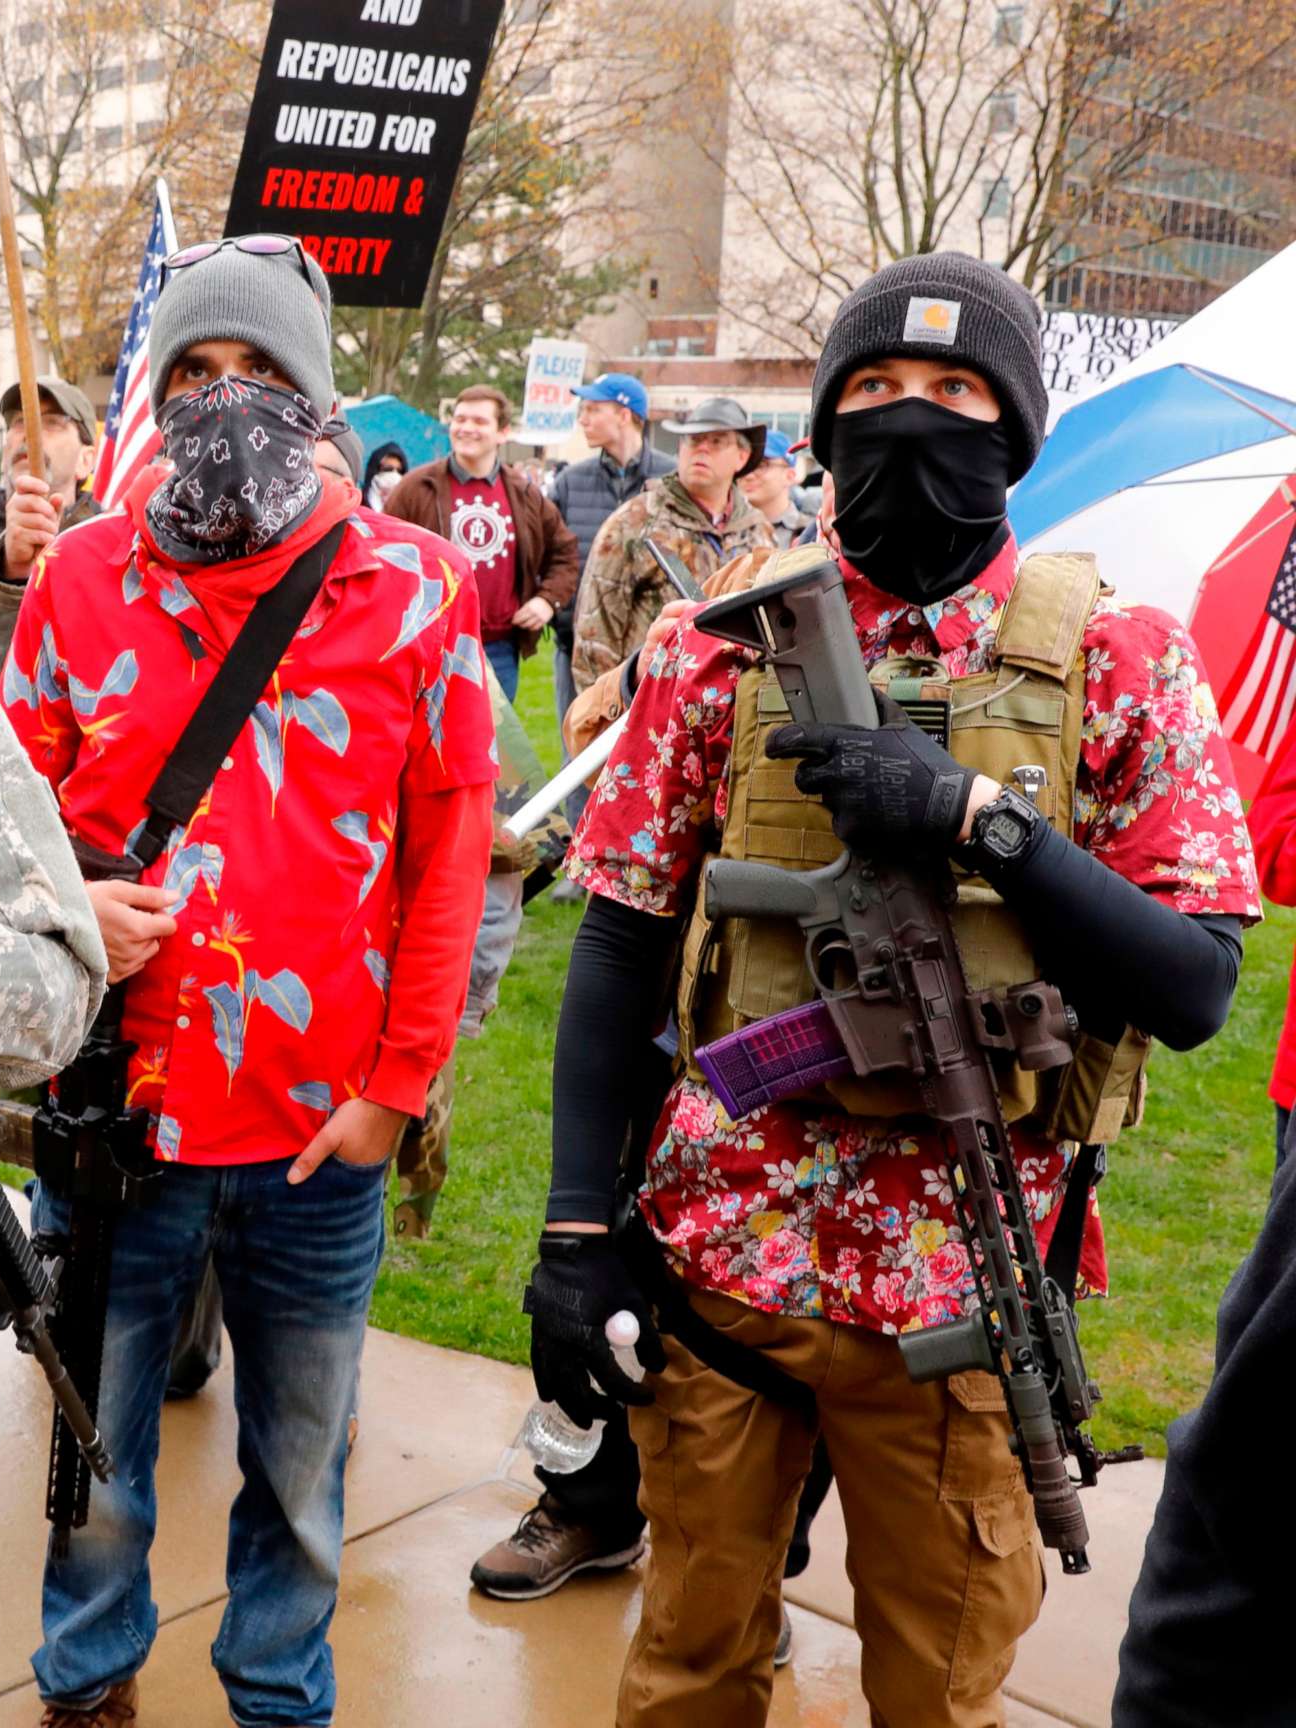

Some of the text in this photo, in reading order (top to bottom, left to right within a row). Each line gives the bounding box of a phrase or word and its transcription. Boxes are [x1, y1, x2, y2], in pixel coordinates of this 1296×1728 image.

[360, 0, 422, 26] AND
[277, 39, 471, 97] REPUBLICANS
[275, 104, 437, 155] UNITED FOR
[261, 167, 425, 217] FREEDOM &
[295, 235, 392, 276] BERTY
[1076, 314, 1137, 340] WHO
[1081, 353, 1116, 378] TO
